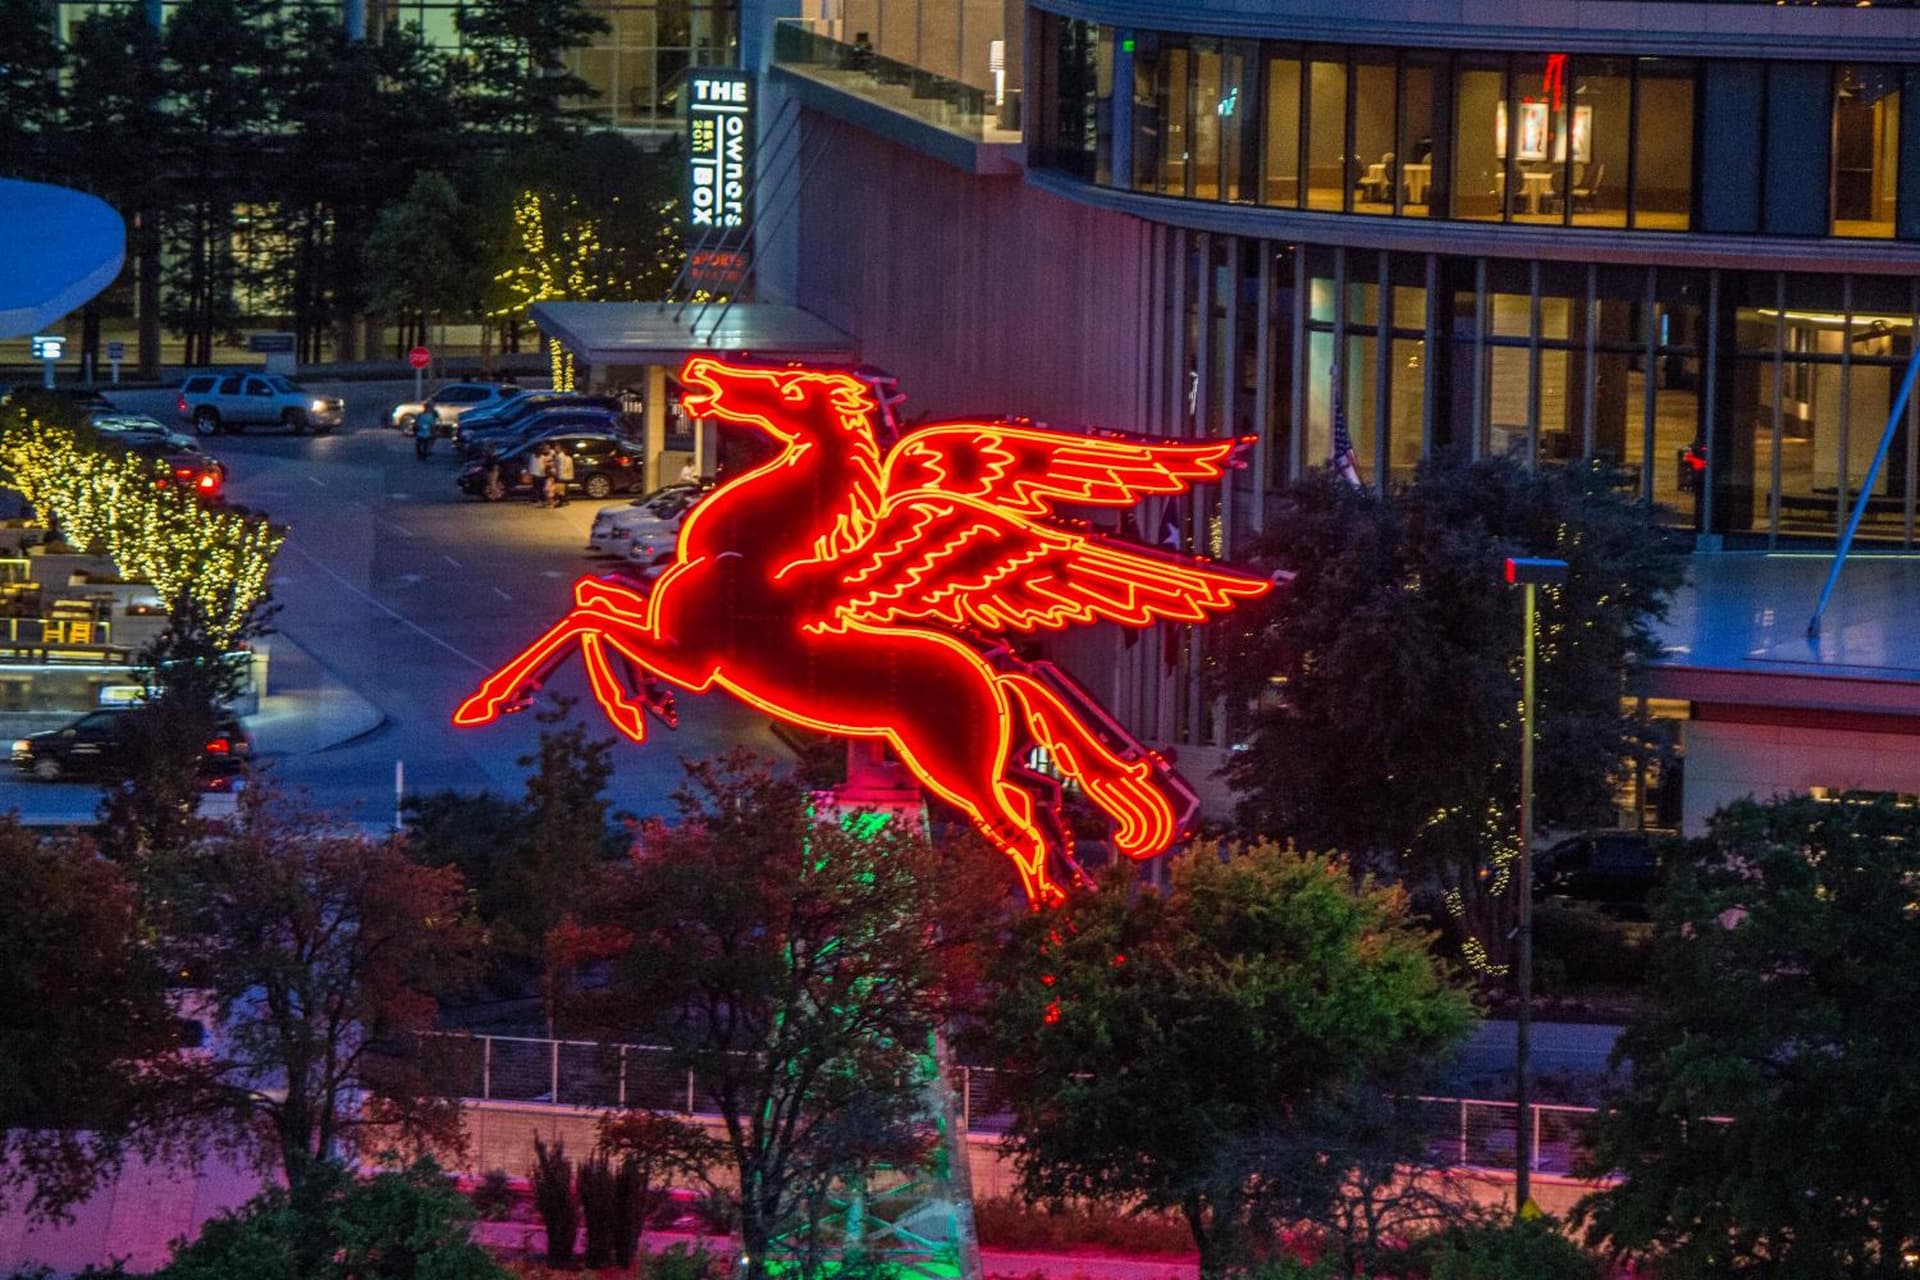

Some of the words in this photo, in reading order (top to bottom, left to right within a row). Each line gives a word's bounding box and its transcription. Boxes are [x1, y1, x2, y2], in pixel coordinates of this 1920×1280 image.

[694, 80, 746, 101] THE
[692, 120, 703, 152] 2011
[693, 167, 713, 225] BOX
